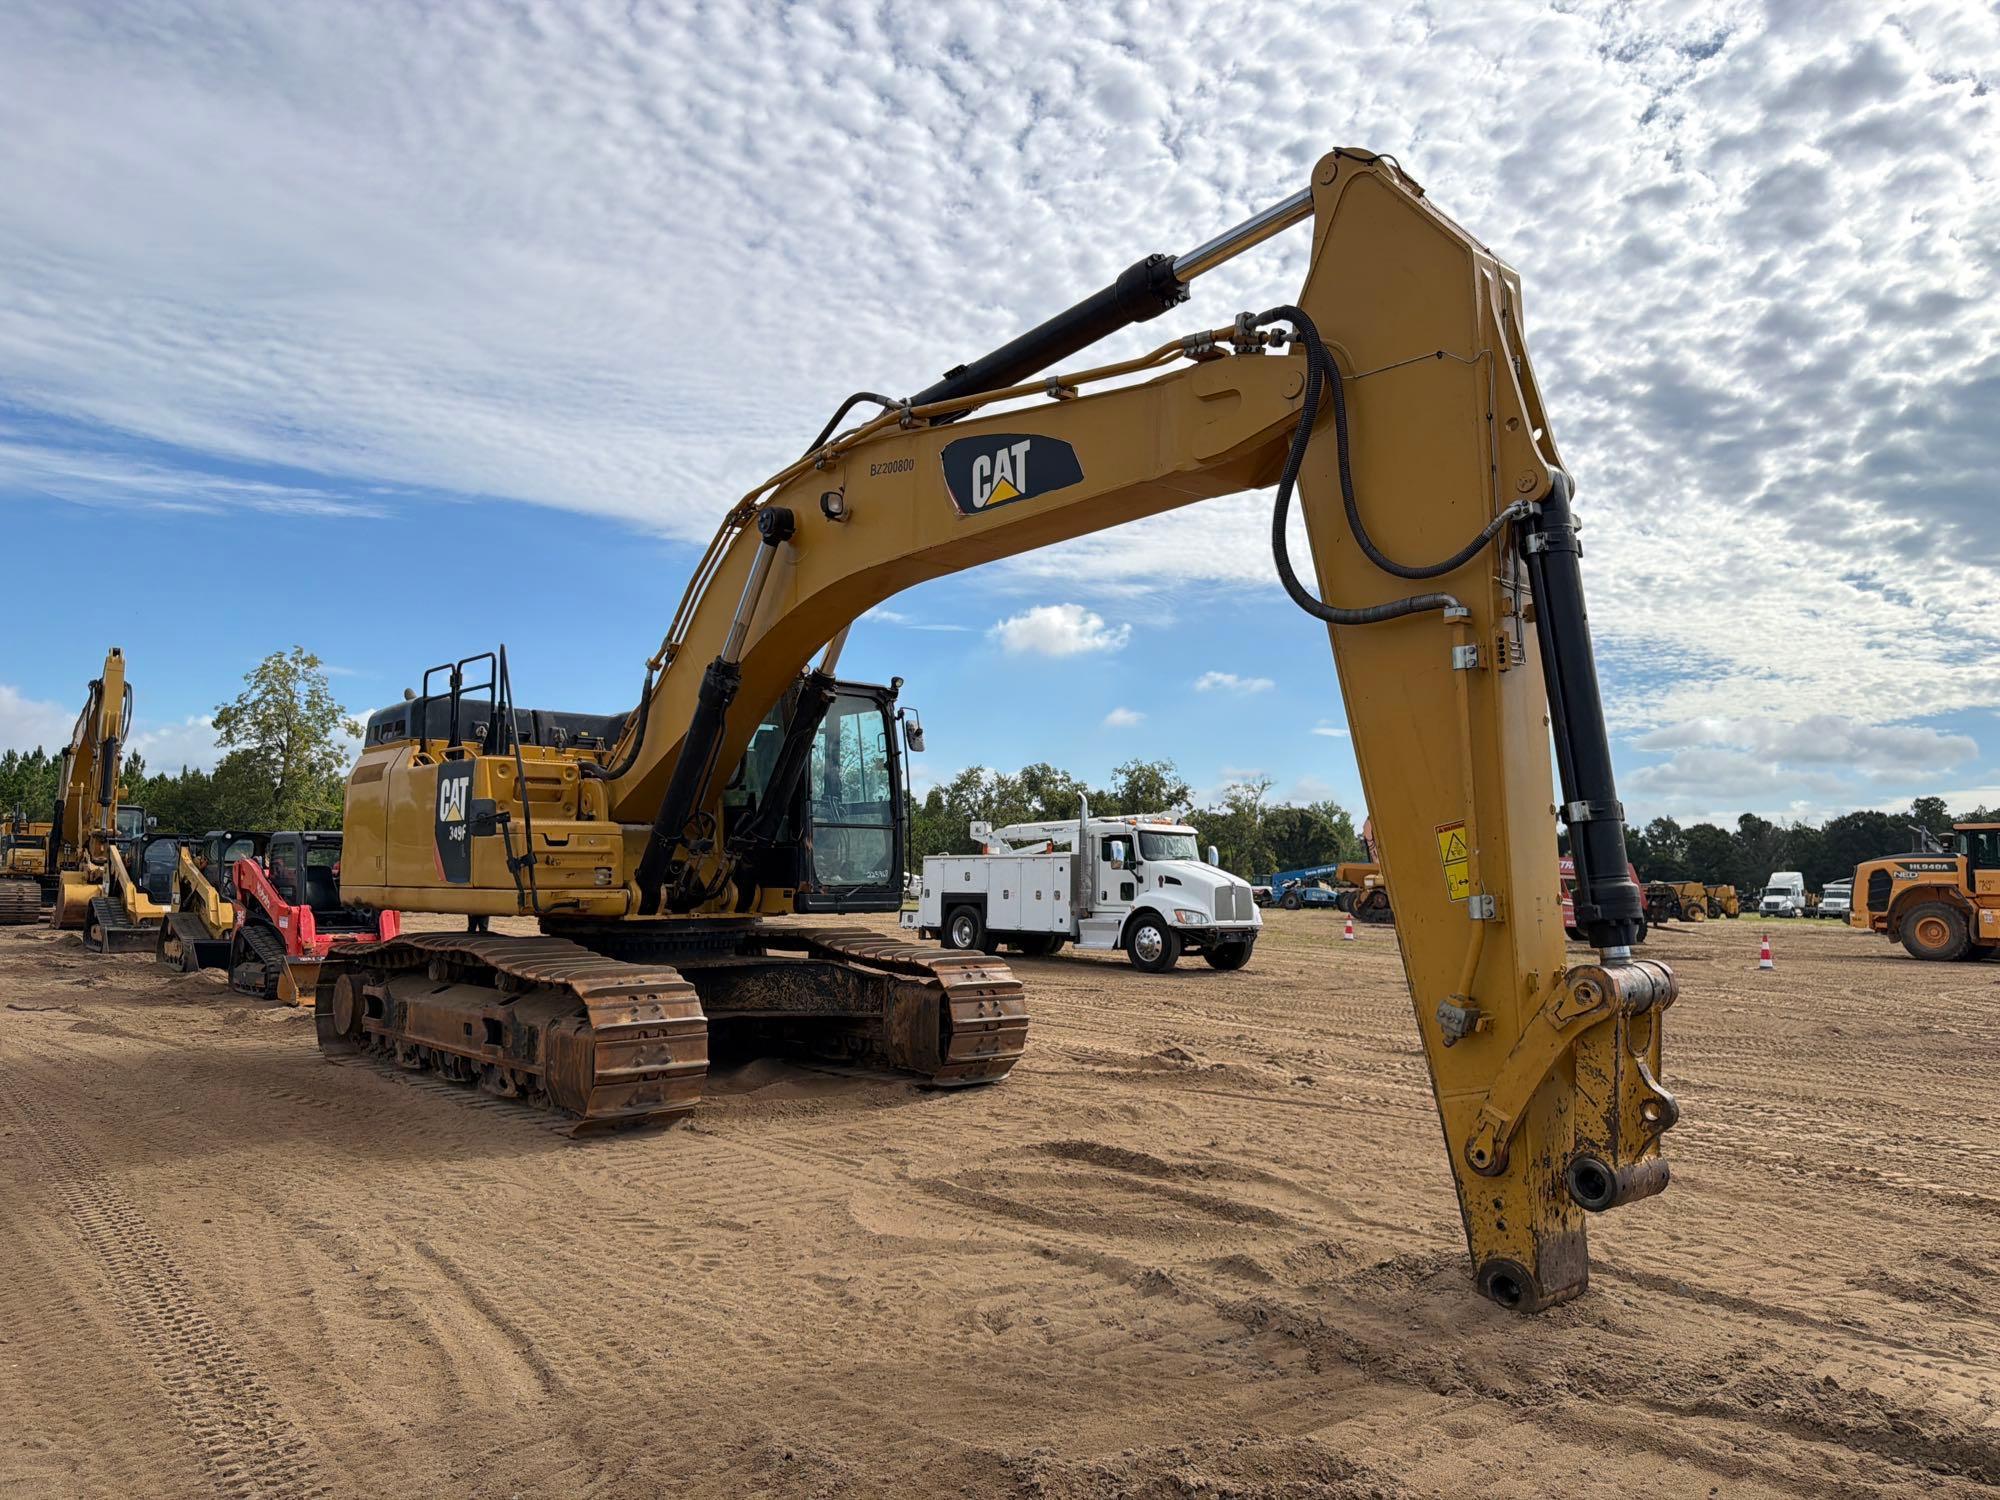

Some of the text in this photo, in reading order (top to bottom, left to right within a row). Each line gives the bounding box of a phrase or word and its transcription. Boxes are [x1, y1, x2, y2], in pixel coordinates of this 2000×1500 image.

[870, 458, 915, 477] BZ200800
[972, 439, 1031, 508] CAT
[440, 777, 470, 822] CAT
[449, 824, 467, 841] 349F
[1909, 863, 1949, 871] HL940A
